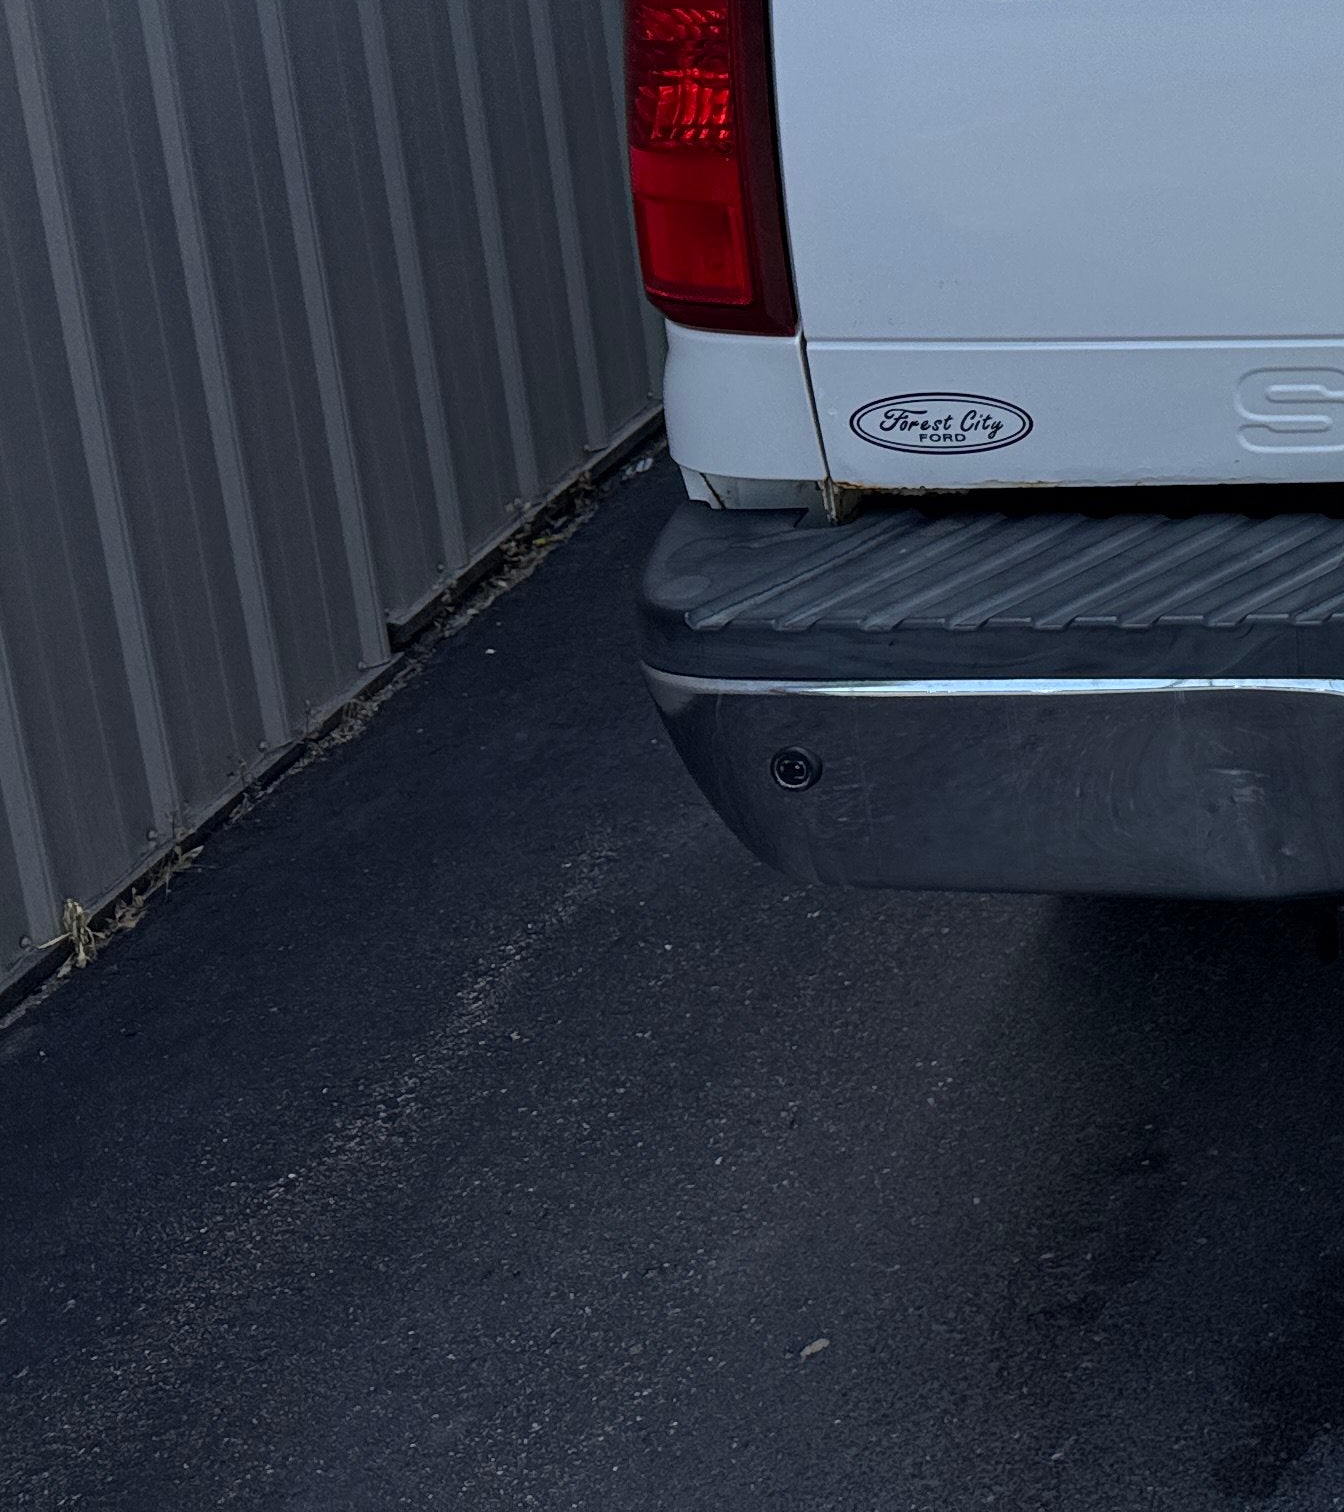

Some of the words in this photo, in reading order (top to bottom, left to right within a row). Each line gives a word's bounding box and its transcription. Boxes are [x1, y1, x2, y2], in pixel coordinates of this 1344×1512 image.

[879, 408, 954, 432] Forest
[959, 409, 1004, 440] City
[918, 433, 967, 443] FORD
